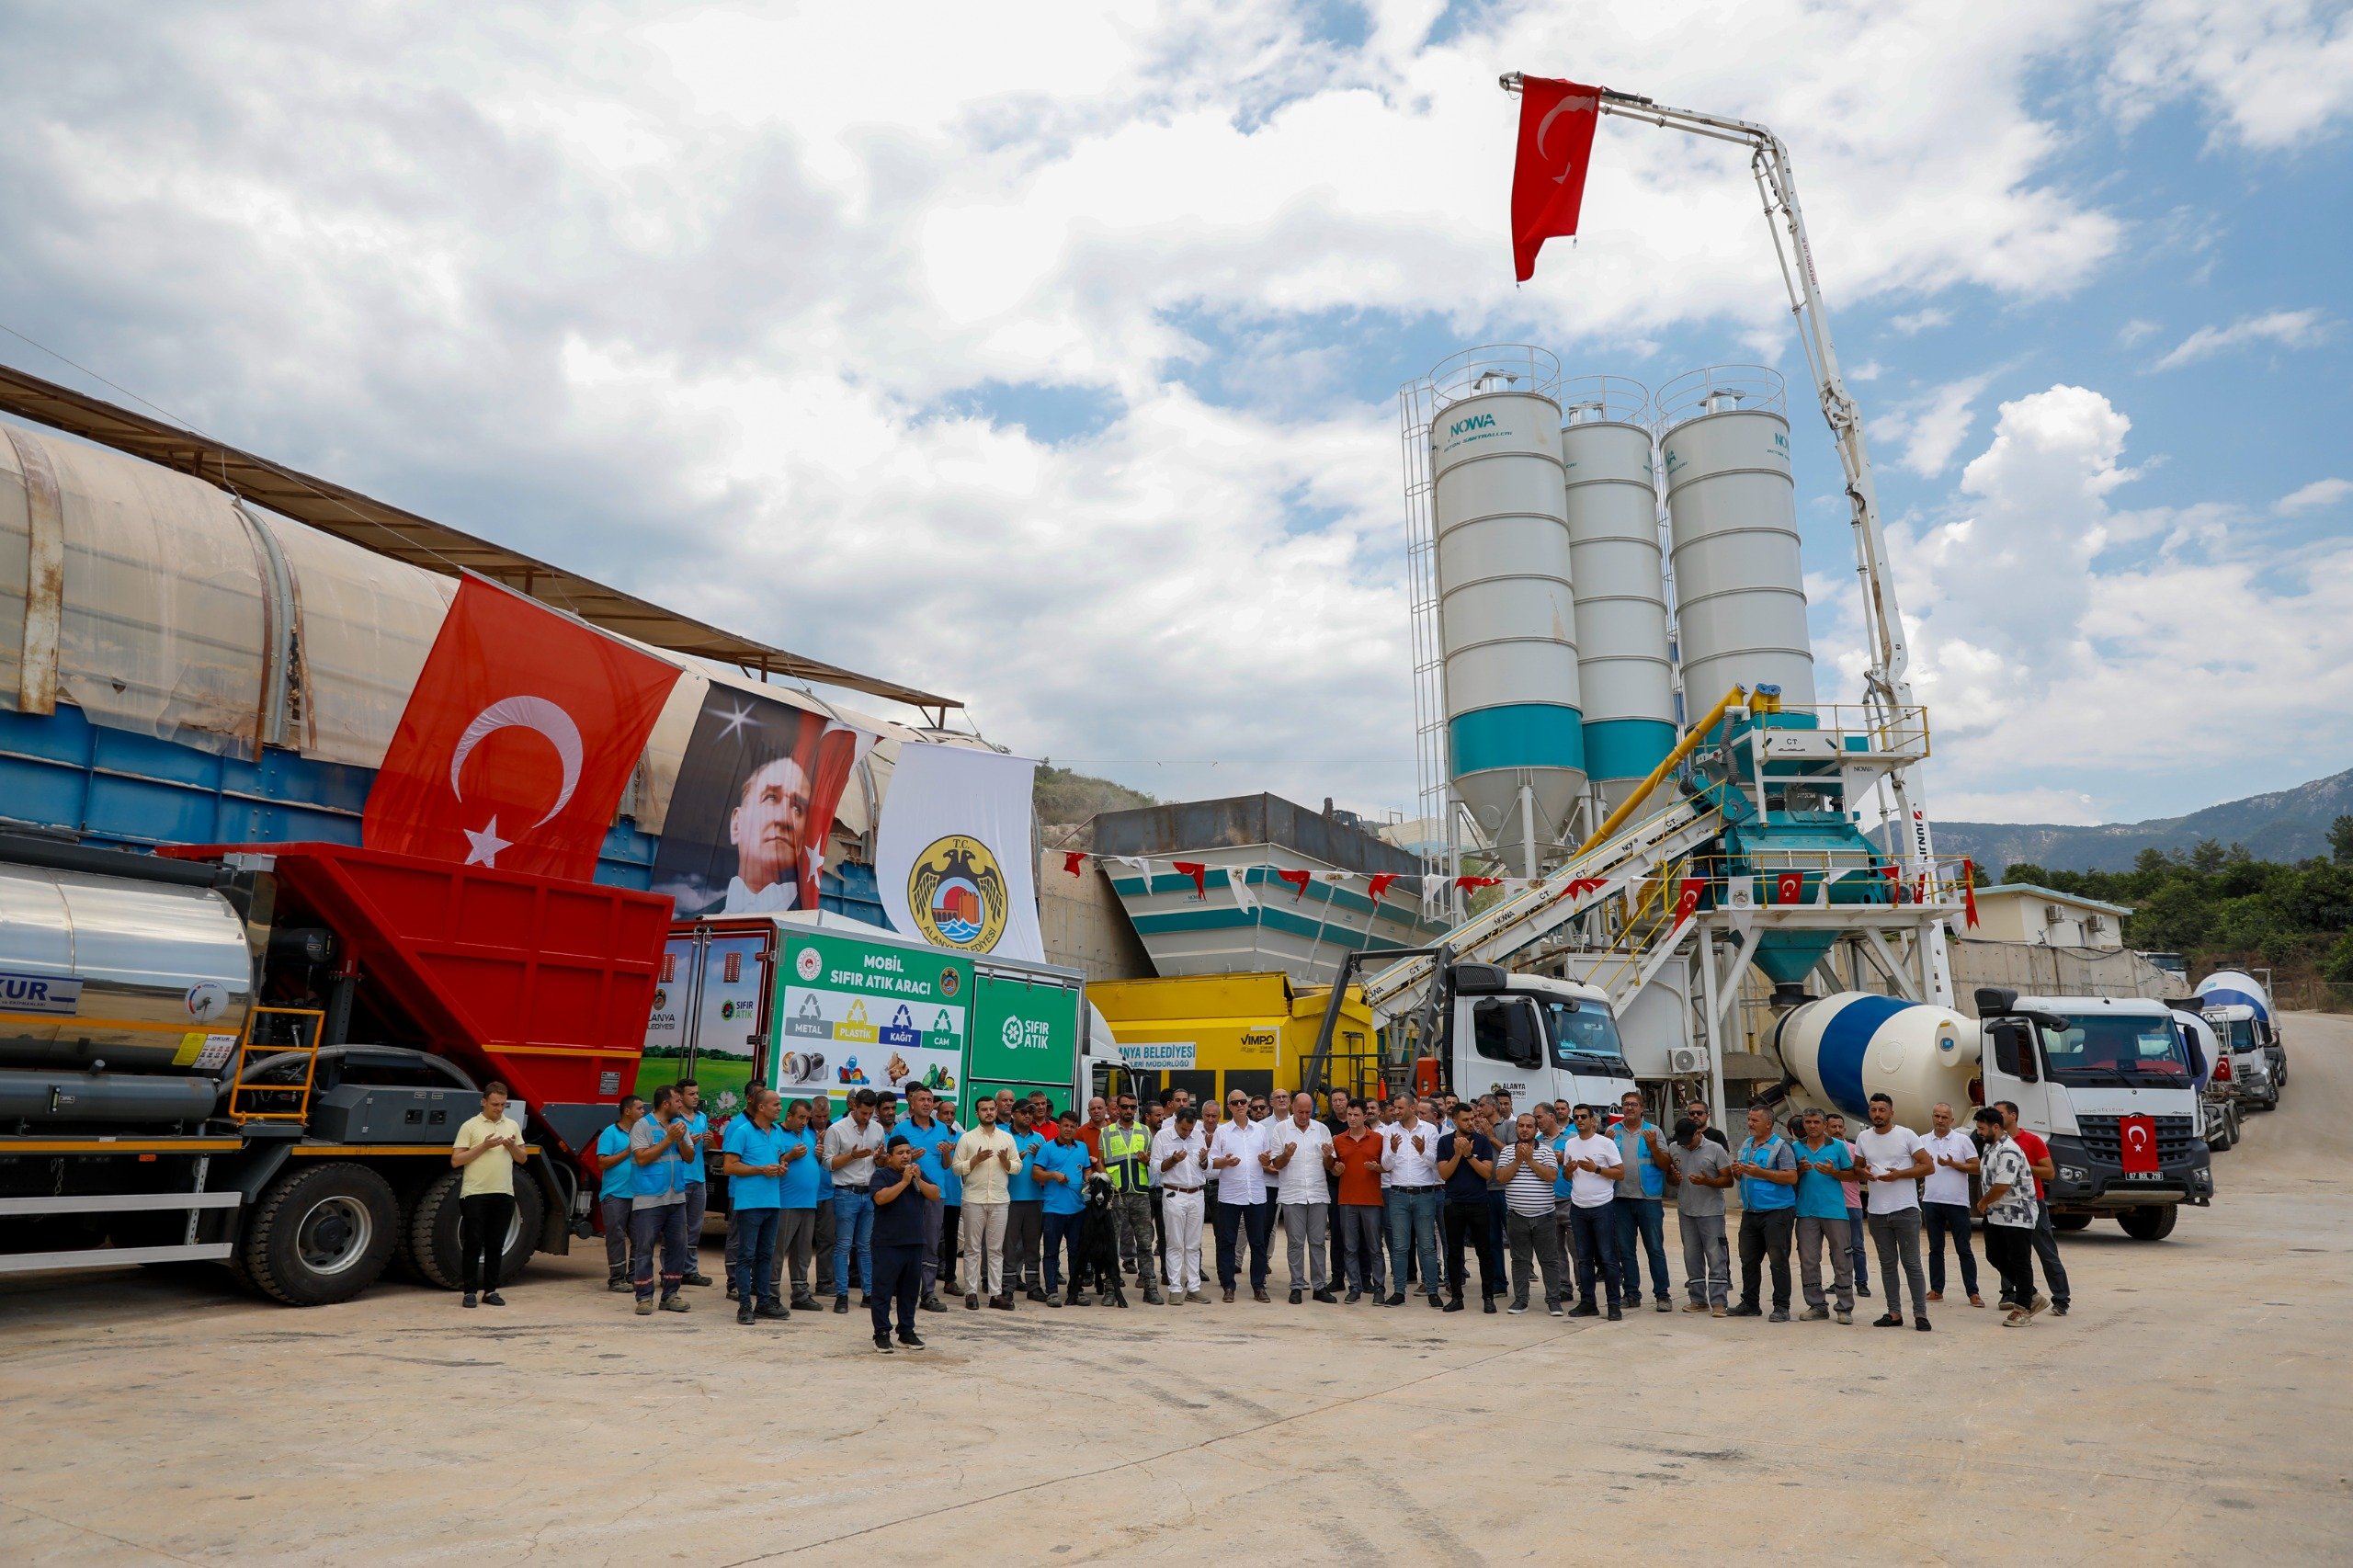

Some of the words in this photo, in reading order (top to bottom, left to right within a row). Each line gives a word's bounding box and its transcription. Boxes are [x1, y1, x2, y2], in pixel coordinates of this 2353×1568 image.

[1450, 414, 1495, 437] NOWA
[1774, 432, 1790, 451] NO
[953, 838, 971, 849] T.C.
[864, 954, 904, 973] MOBİL
[830, 970, 864, 987] SIFIR
[865, 974, 894, 991] ATIK
[894, 978, 931, 995] ARACI
[736, 1001, 754, 1010] SIFIR
[736, 1010, 753, 1019] ATIK
[795, 1023, 823, 1035] METAL
[1025, 1019, 1050, 1035] SIFIR
[839, 1028, 871, 1040] PLASTİK
[890, 1030, 913, 1043] KAĞIT
[934, 1036, 949, 1047] CAM
[1024, 1033, 1049, 1050] ATIK
[1143, 1043, 1195, 1059] BELEDİYESİ
[1145, 1059, 1189, 1069] MÜDÜRLÜĞÜ
